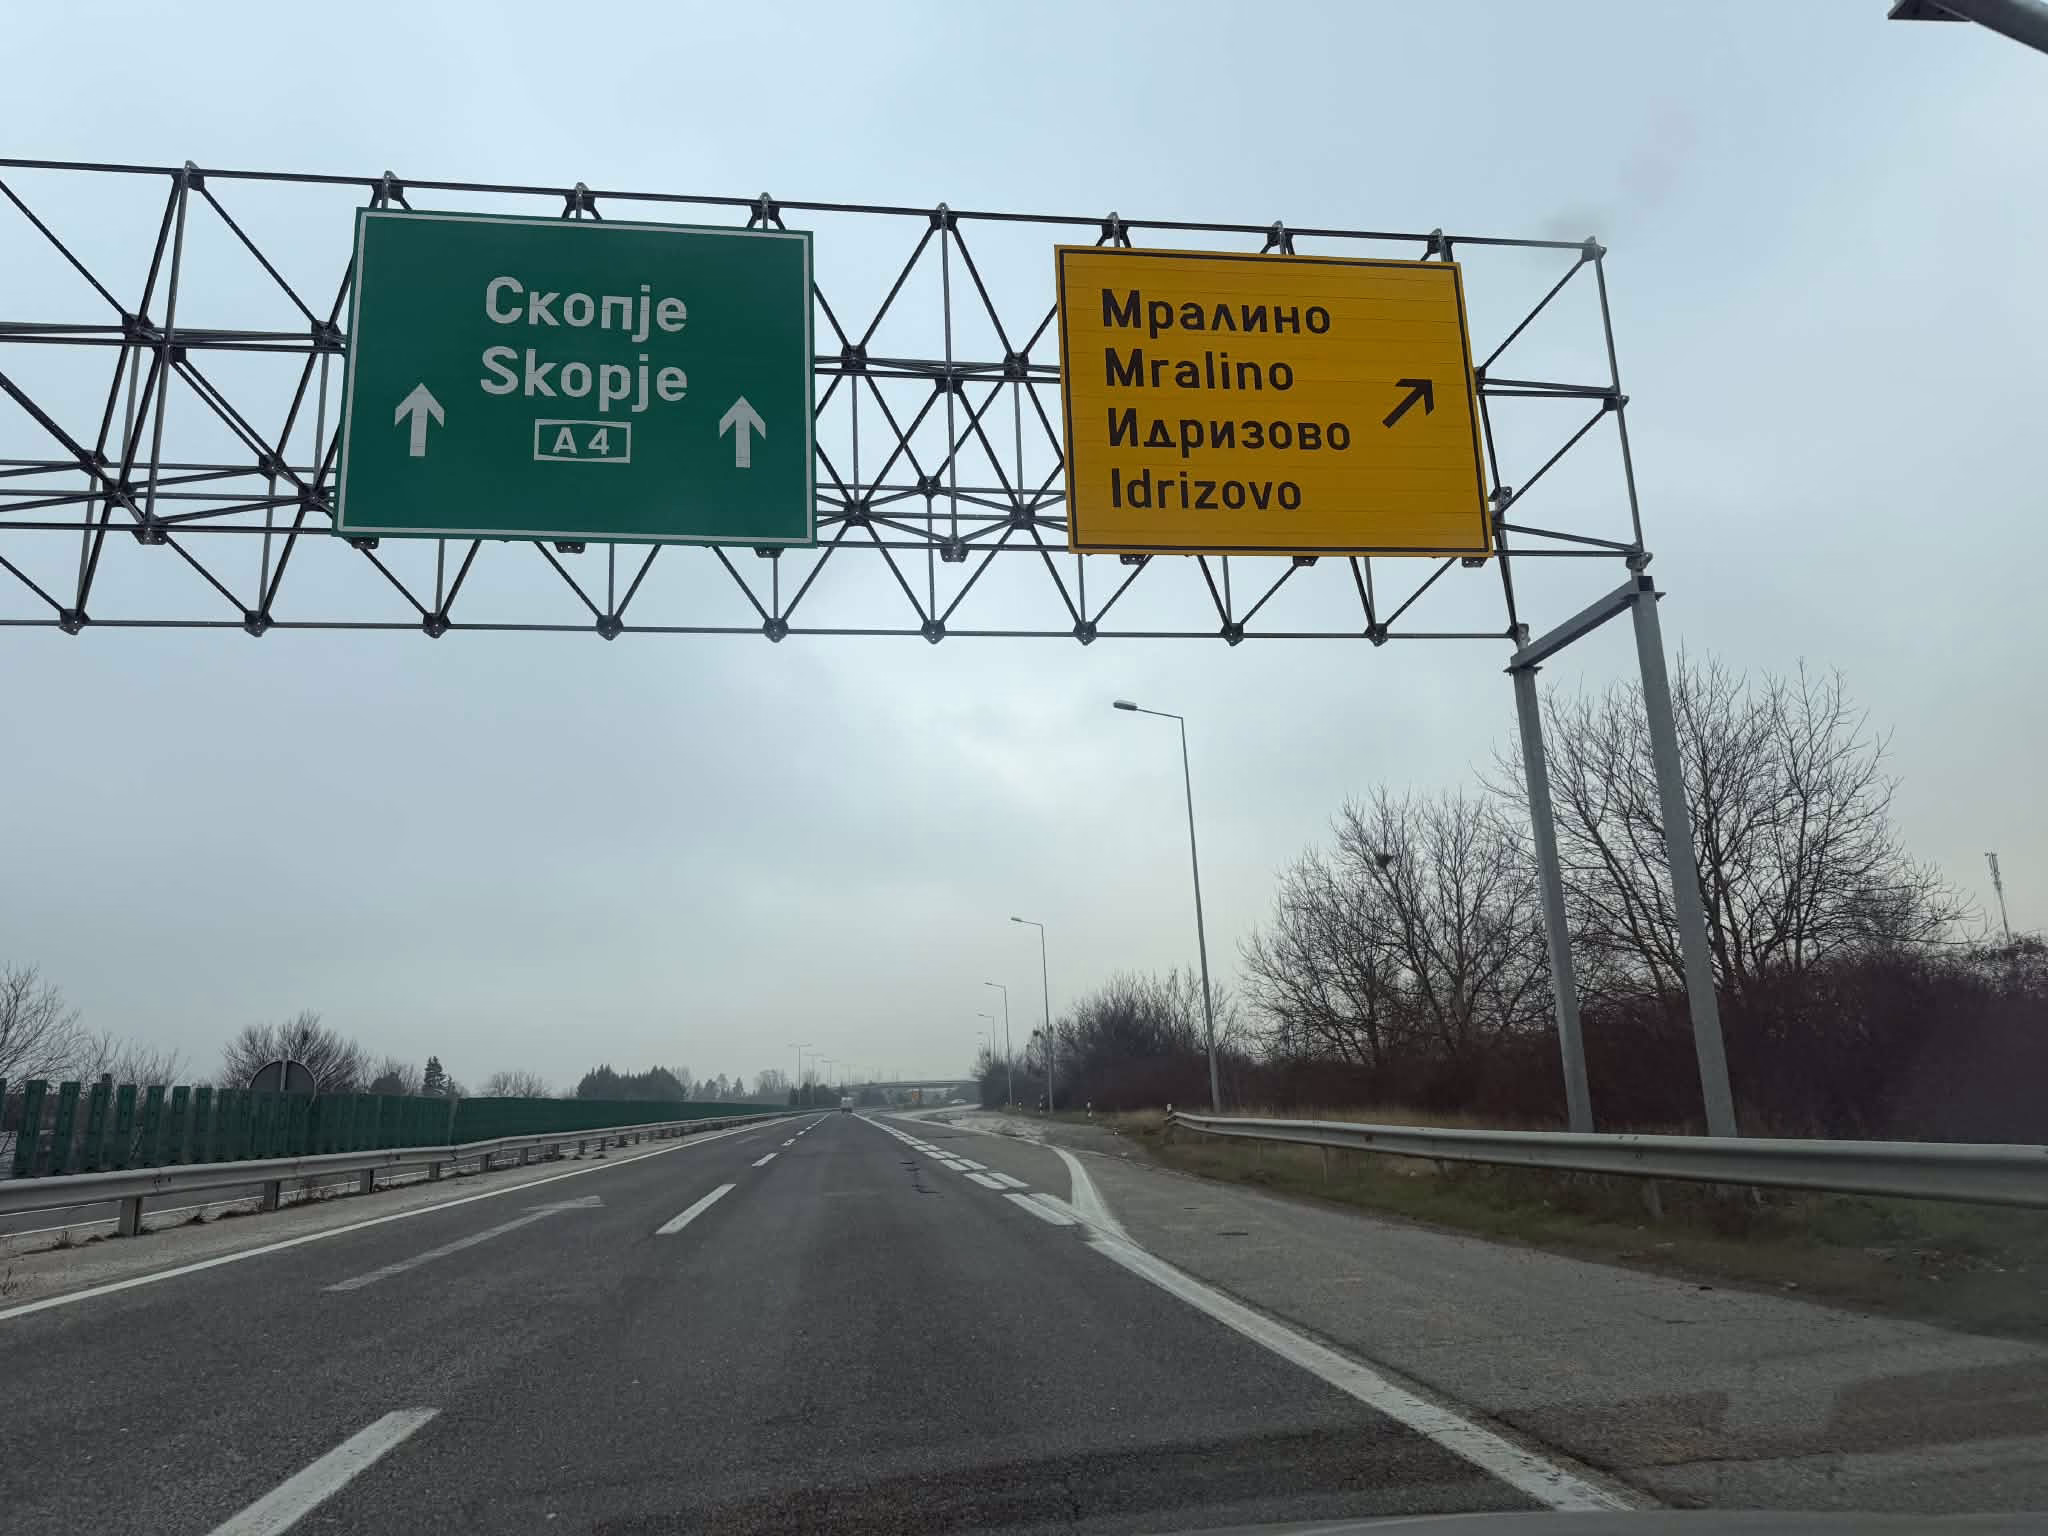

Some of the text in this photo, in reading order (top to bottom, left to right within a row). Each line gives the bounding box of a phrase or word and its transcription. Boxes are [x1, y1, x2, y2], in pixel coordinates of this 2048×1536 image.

[485, 276, 687, 343] Скопје
[1101, 288, 1331, 339] Мралино
[480, 345, 688, 413] Skopje
[1104, 347, 1294, 391] Mralino
[552, 426, 610, 456] A 4
[1107, 407, 1351, 458] Идризово
[1111, 467, 1302, 511] Idrizovo
